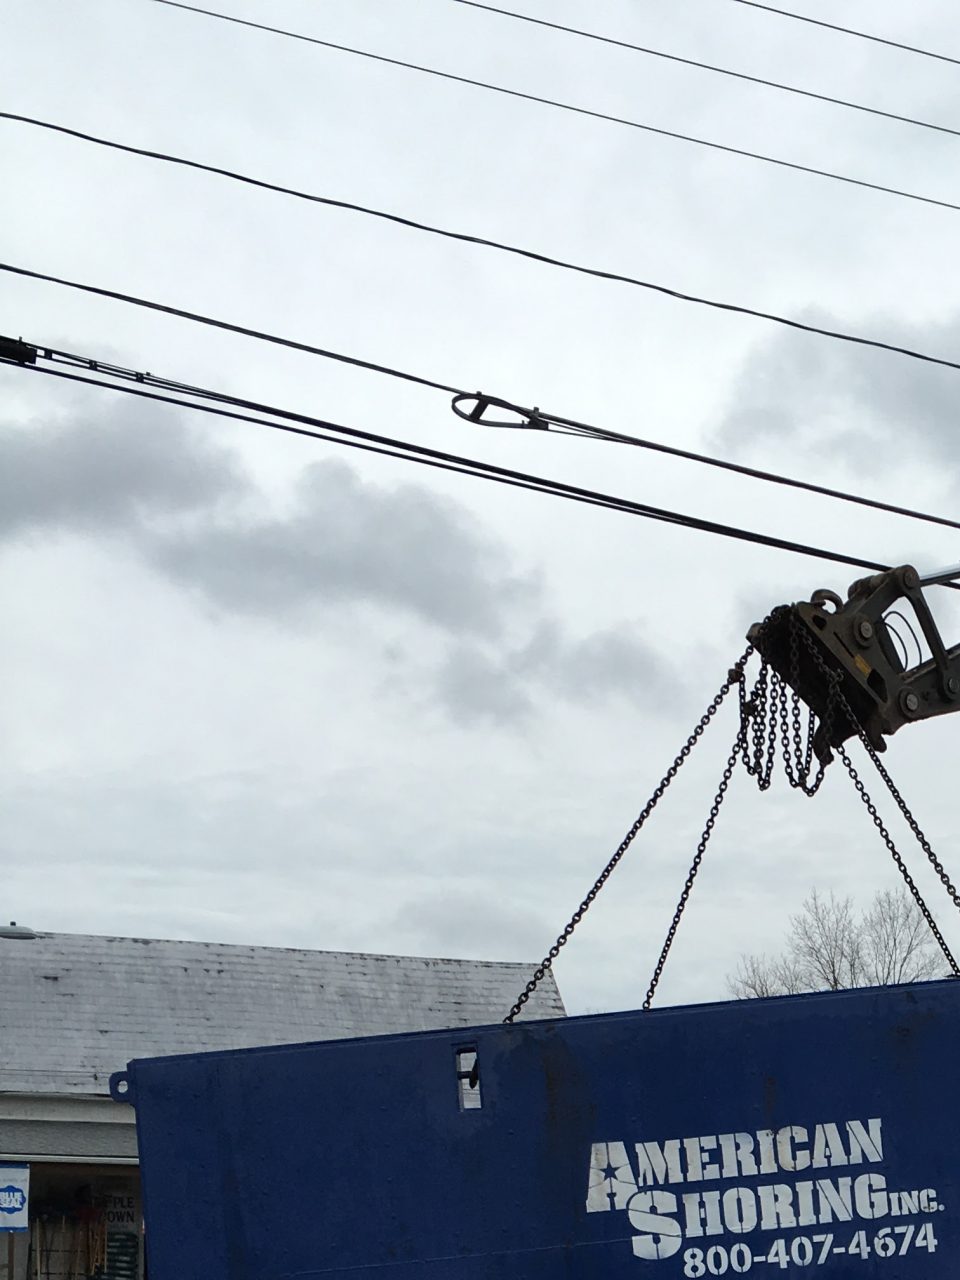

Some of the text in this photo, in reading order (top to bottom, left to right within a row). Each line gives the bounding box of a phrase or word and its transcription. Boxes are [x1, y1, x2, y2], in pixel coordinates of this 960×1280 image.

[586, 1118, 884, 1214] AMERICAN
[628, 1173, 945, 1261] SHORING INC.
[682, 1222, 939, 1279] 800-407-4674
